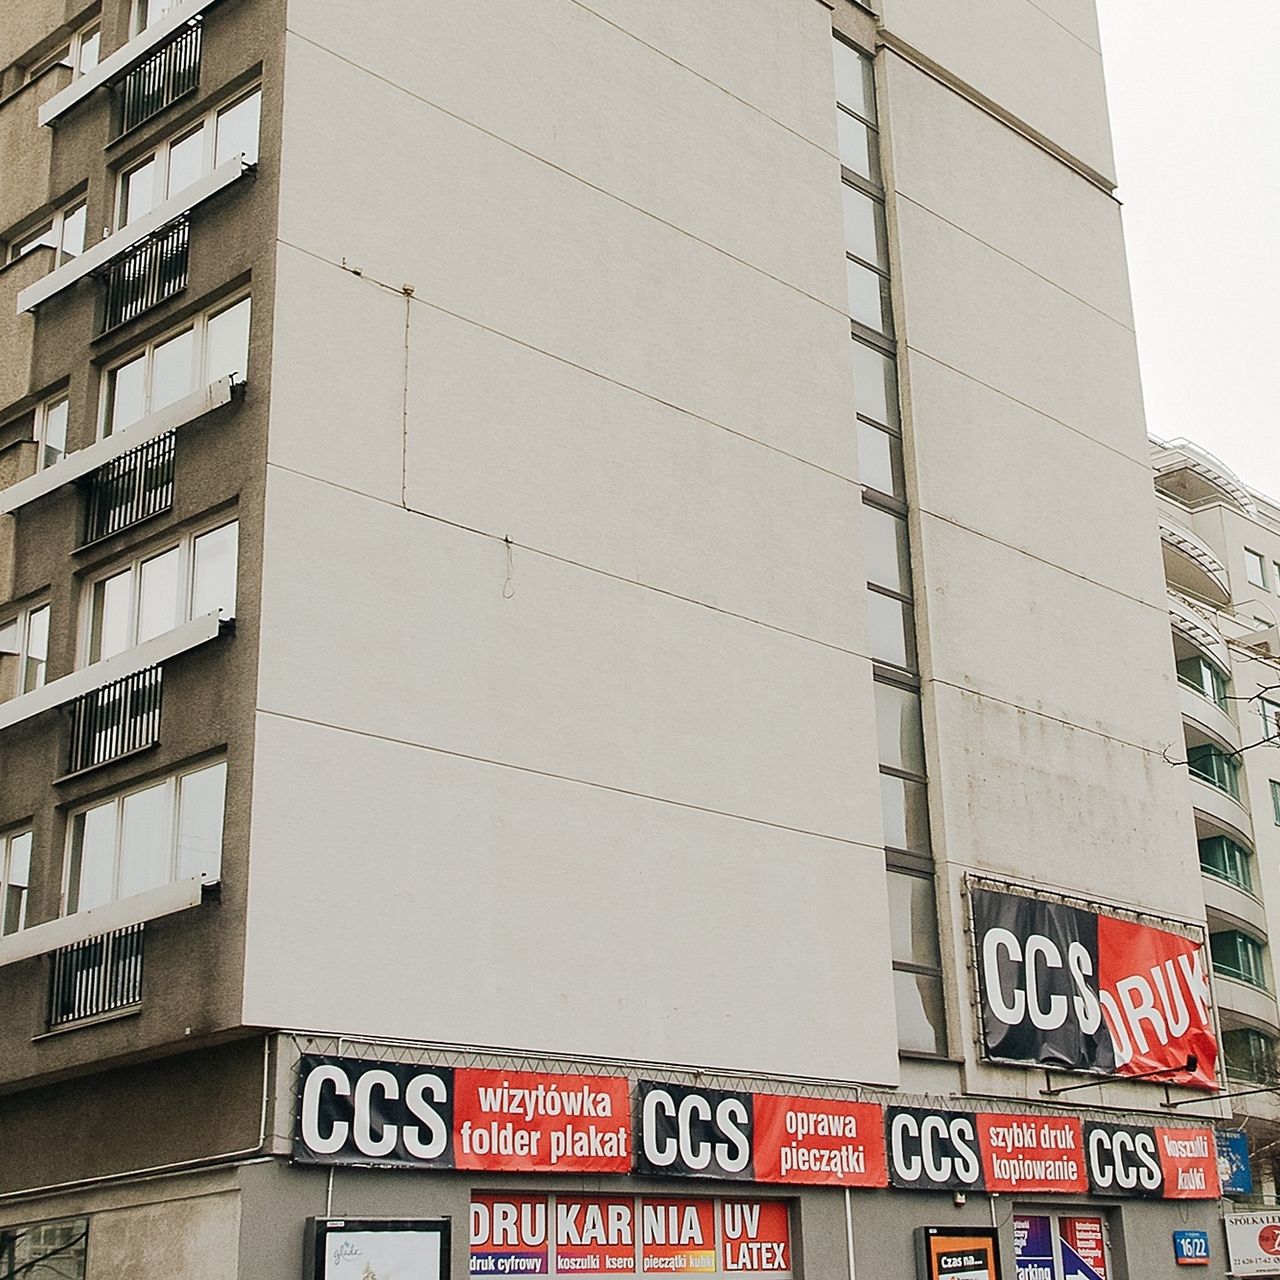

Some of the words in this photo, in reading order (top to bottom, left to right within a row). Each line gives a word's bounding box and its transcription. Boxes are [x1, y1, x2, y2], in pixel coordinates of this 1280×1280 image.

[982, 927, 1101, 1035] CCS
[301, 1064, 448, 1159] CCS
[478, 1080, 612, 1121] wizytówka
[460, 1121, 541, 1156] folder
[550, 1123, 628, 1164] plakat
[642, 1089, 751, 1174] CCS
[785, 1111, 857, 1140] oprawa
[989, 1122, 1036, 1153] szybki
[1040, 1124, 1075, 1150] druk
[780, 1141, 866, 1178] pieczątki
[891, 1113, 980, 1184] CCS
[1089, 1128, 1162, 1190] CCS
[992, 1153, 1078, 1185] kopiowanie
[724, 1203, 761, 1239] UV
[470, 1255, 495, 1271] druk
[497, 1255, 542, 1273] cyfrowy
[557, 1254, 600, 1270] koszulki
[606, 1254, 634, 1269] ksero
[644, 1254, 687, 1273] pieczątki
[725, 1242, 787, 1270] LATEX
[941, 1255, 962, 1269] Czas
[1180, 1238, 1207, 1257] 16/22
